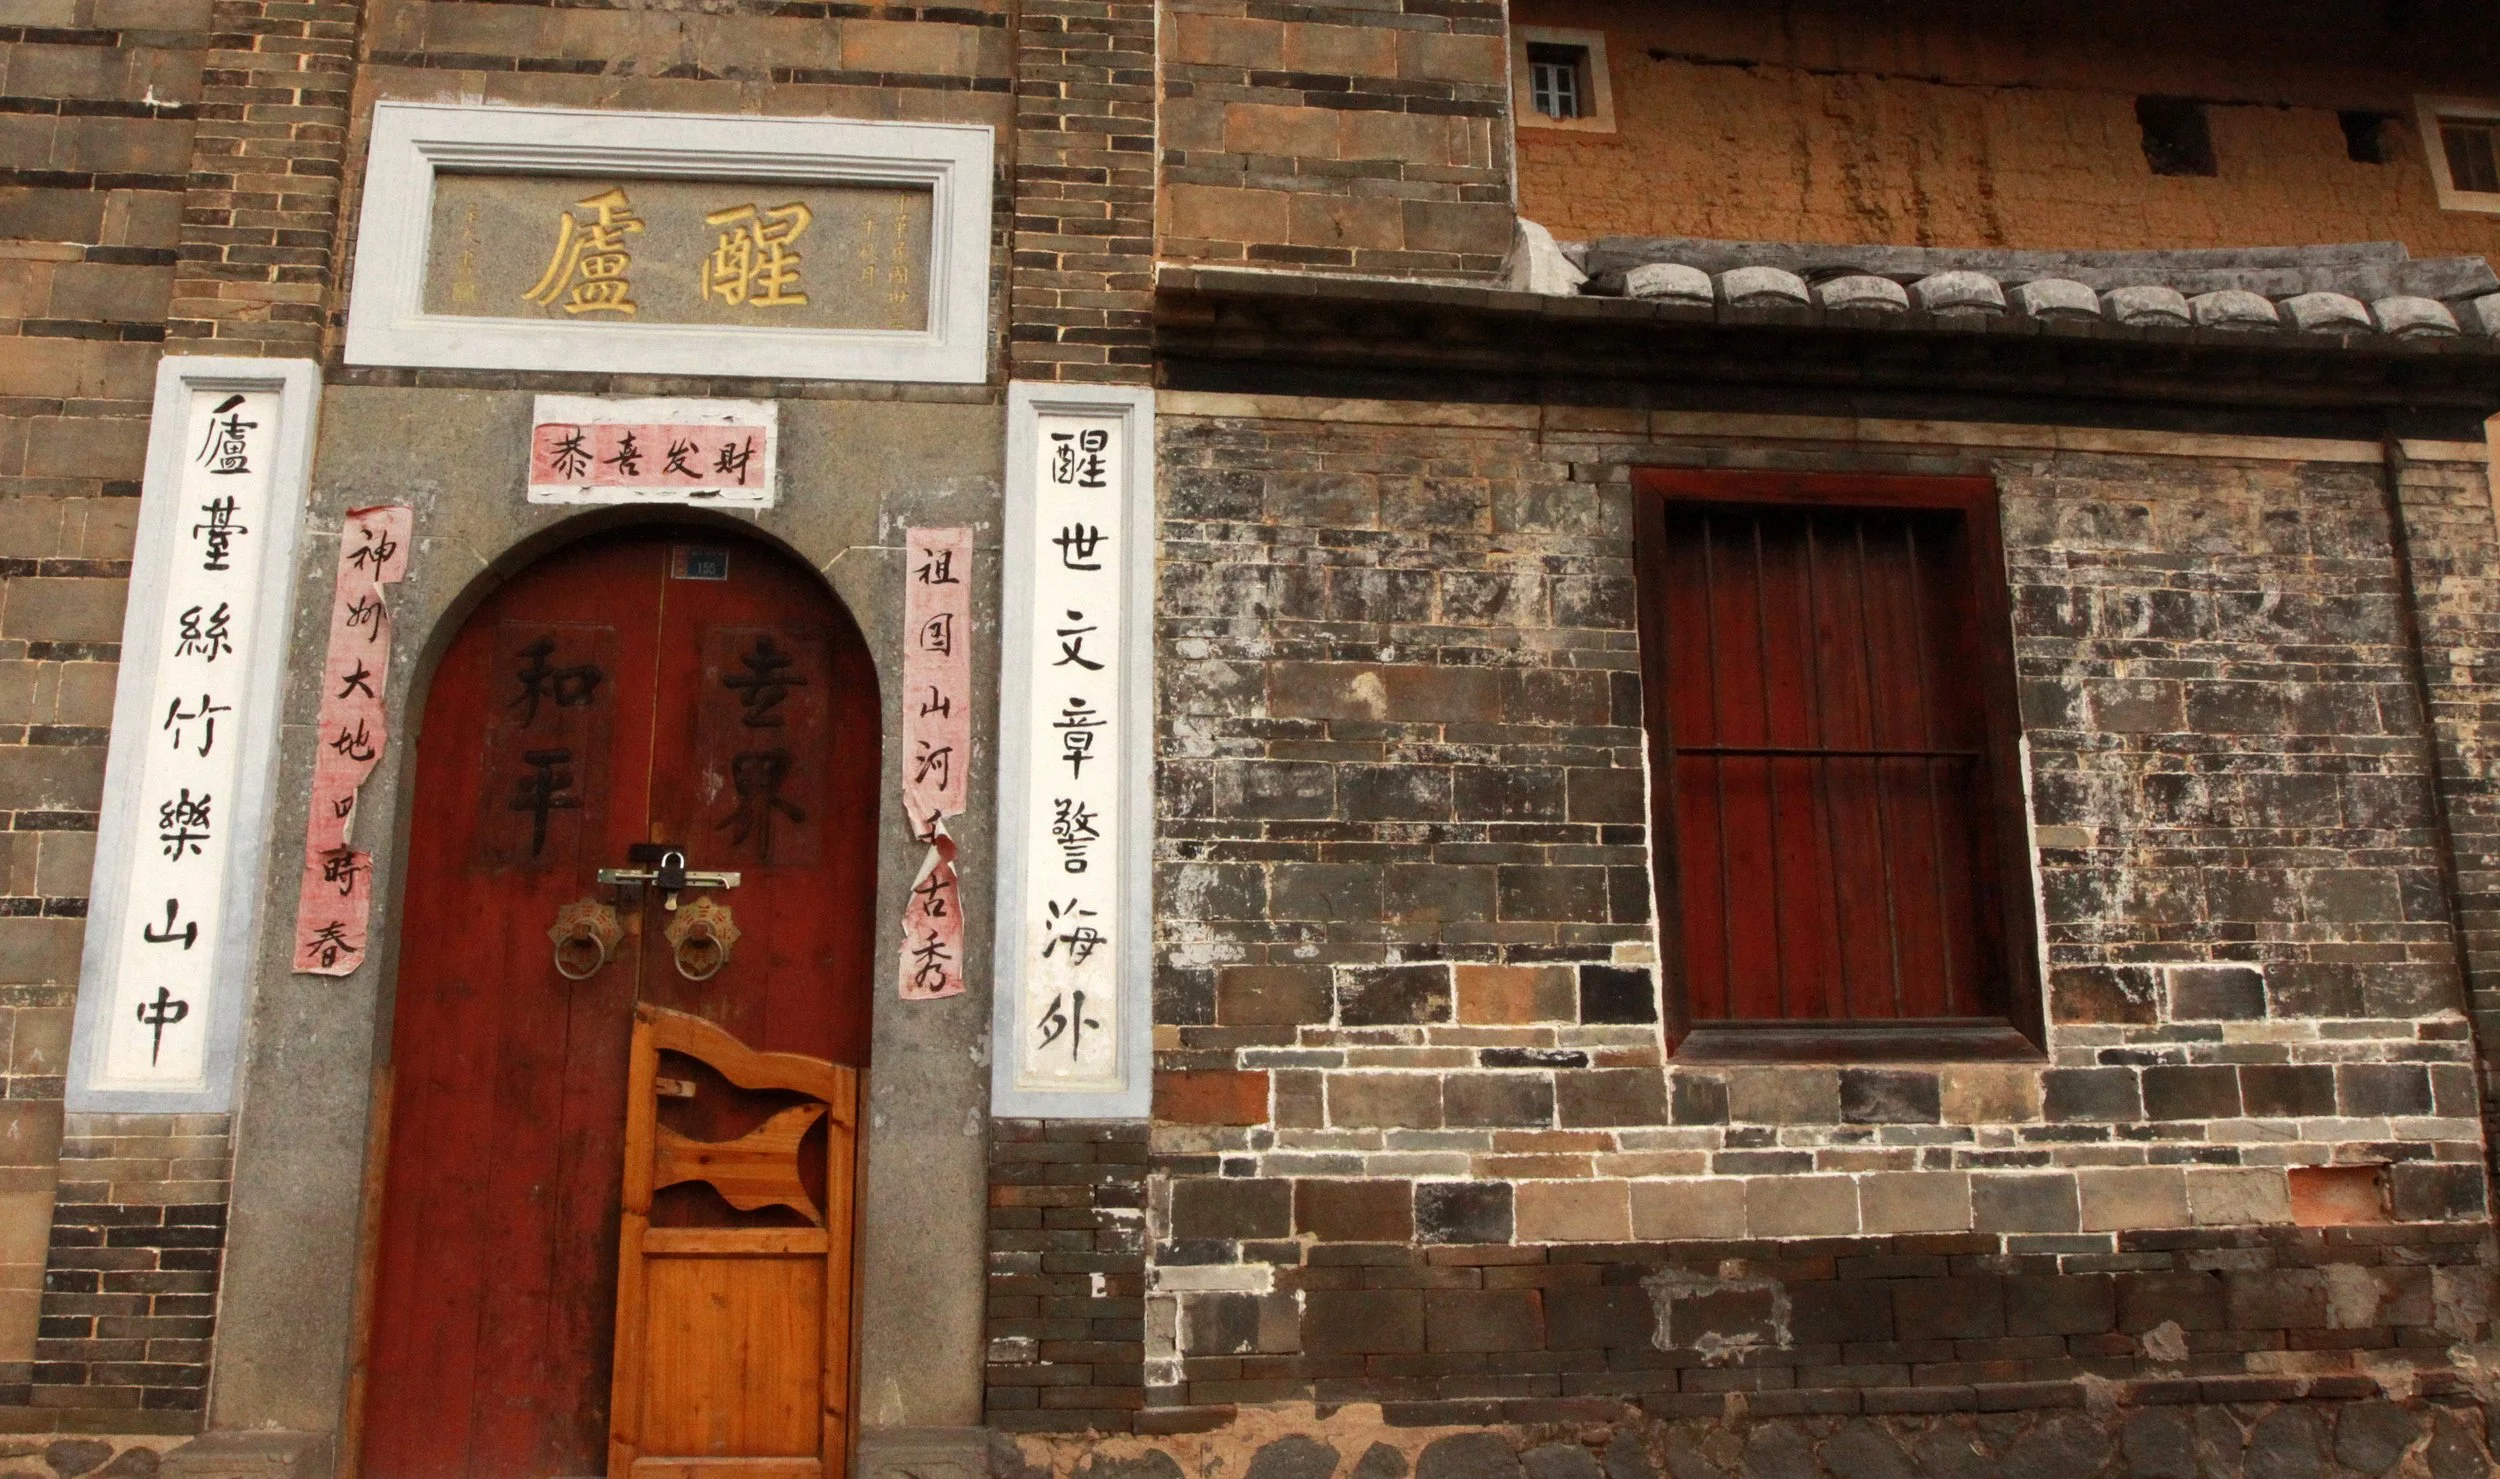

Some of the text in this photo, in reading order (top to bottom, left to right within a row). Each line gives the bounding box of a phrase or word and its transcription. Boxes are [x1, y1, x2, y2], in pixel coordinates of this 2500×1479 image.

[507, 634, 602, 857] 和平
[1036, 429, 1108, 1062] 醒世文章警海外
